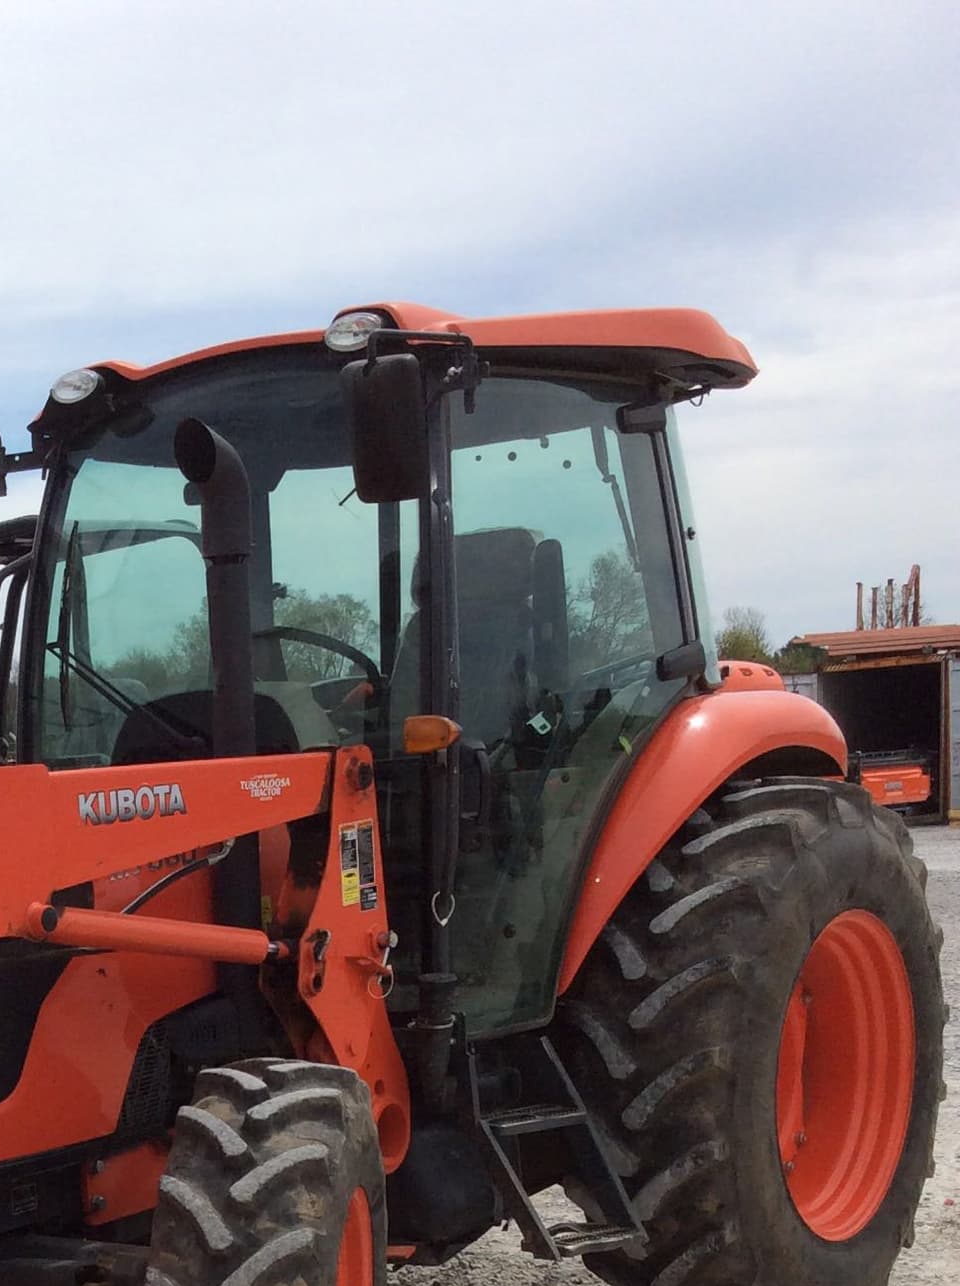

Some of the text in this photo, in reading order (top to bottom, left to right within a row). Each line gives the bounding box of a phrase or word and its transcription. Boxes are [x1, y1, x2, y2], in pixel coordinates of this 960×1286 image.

[240, 777, 290, 790] TUSCALOOSA
[250, 788, 281, 797] TRACTOR
[77, 783, 187, 826] KUBOTA
